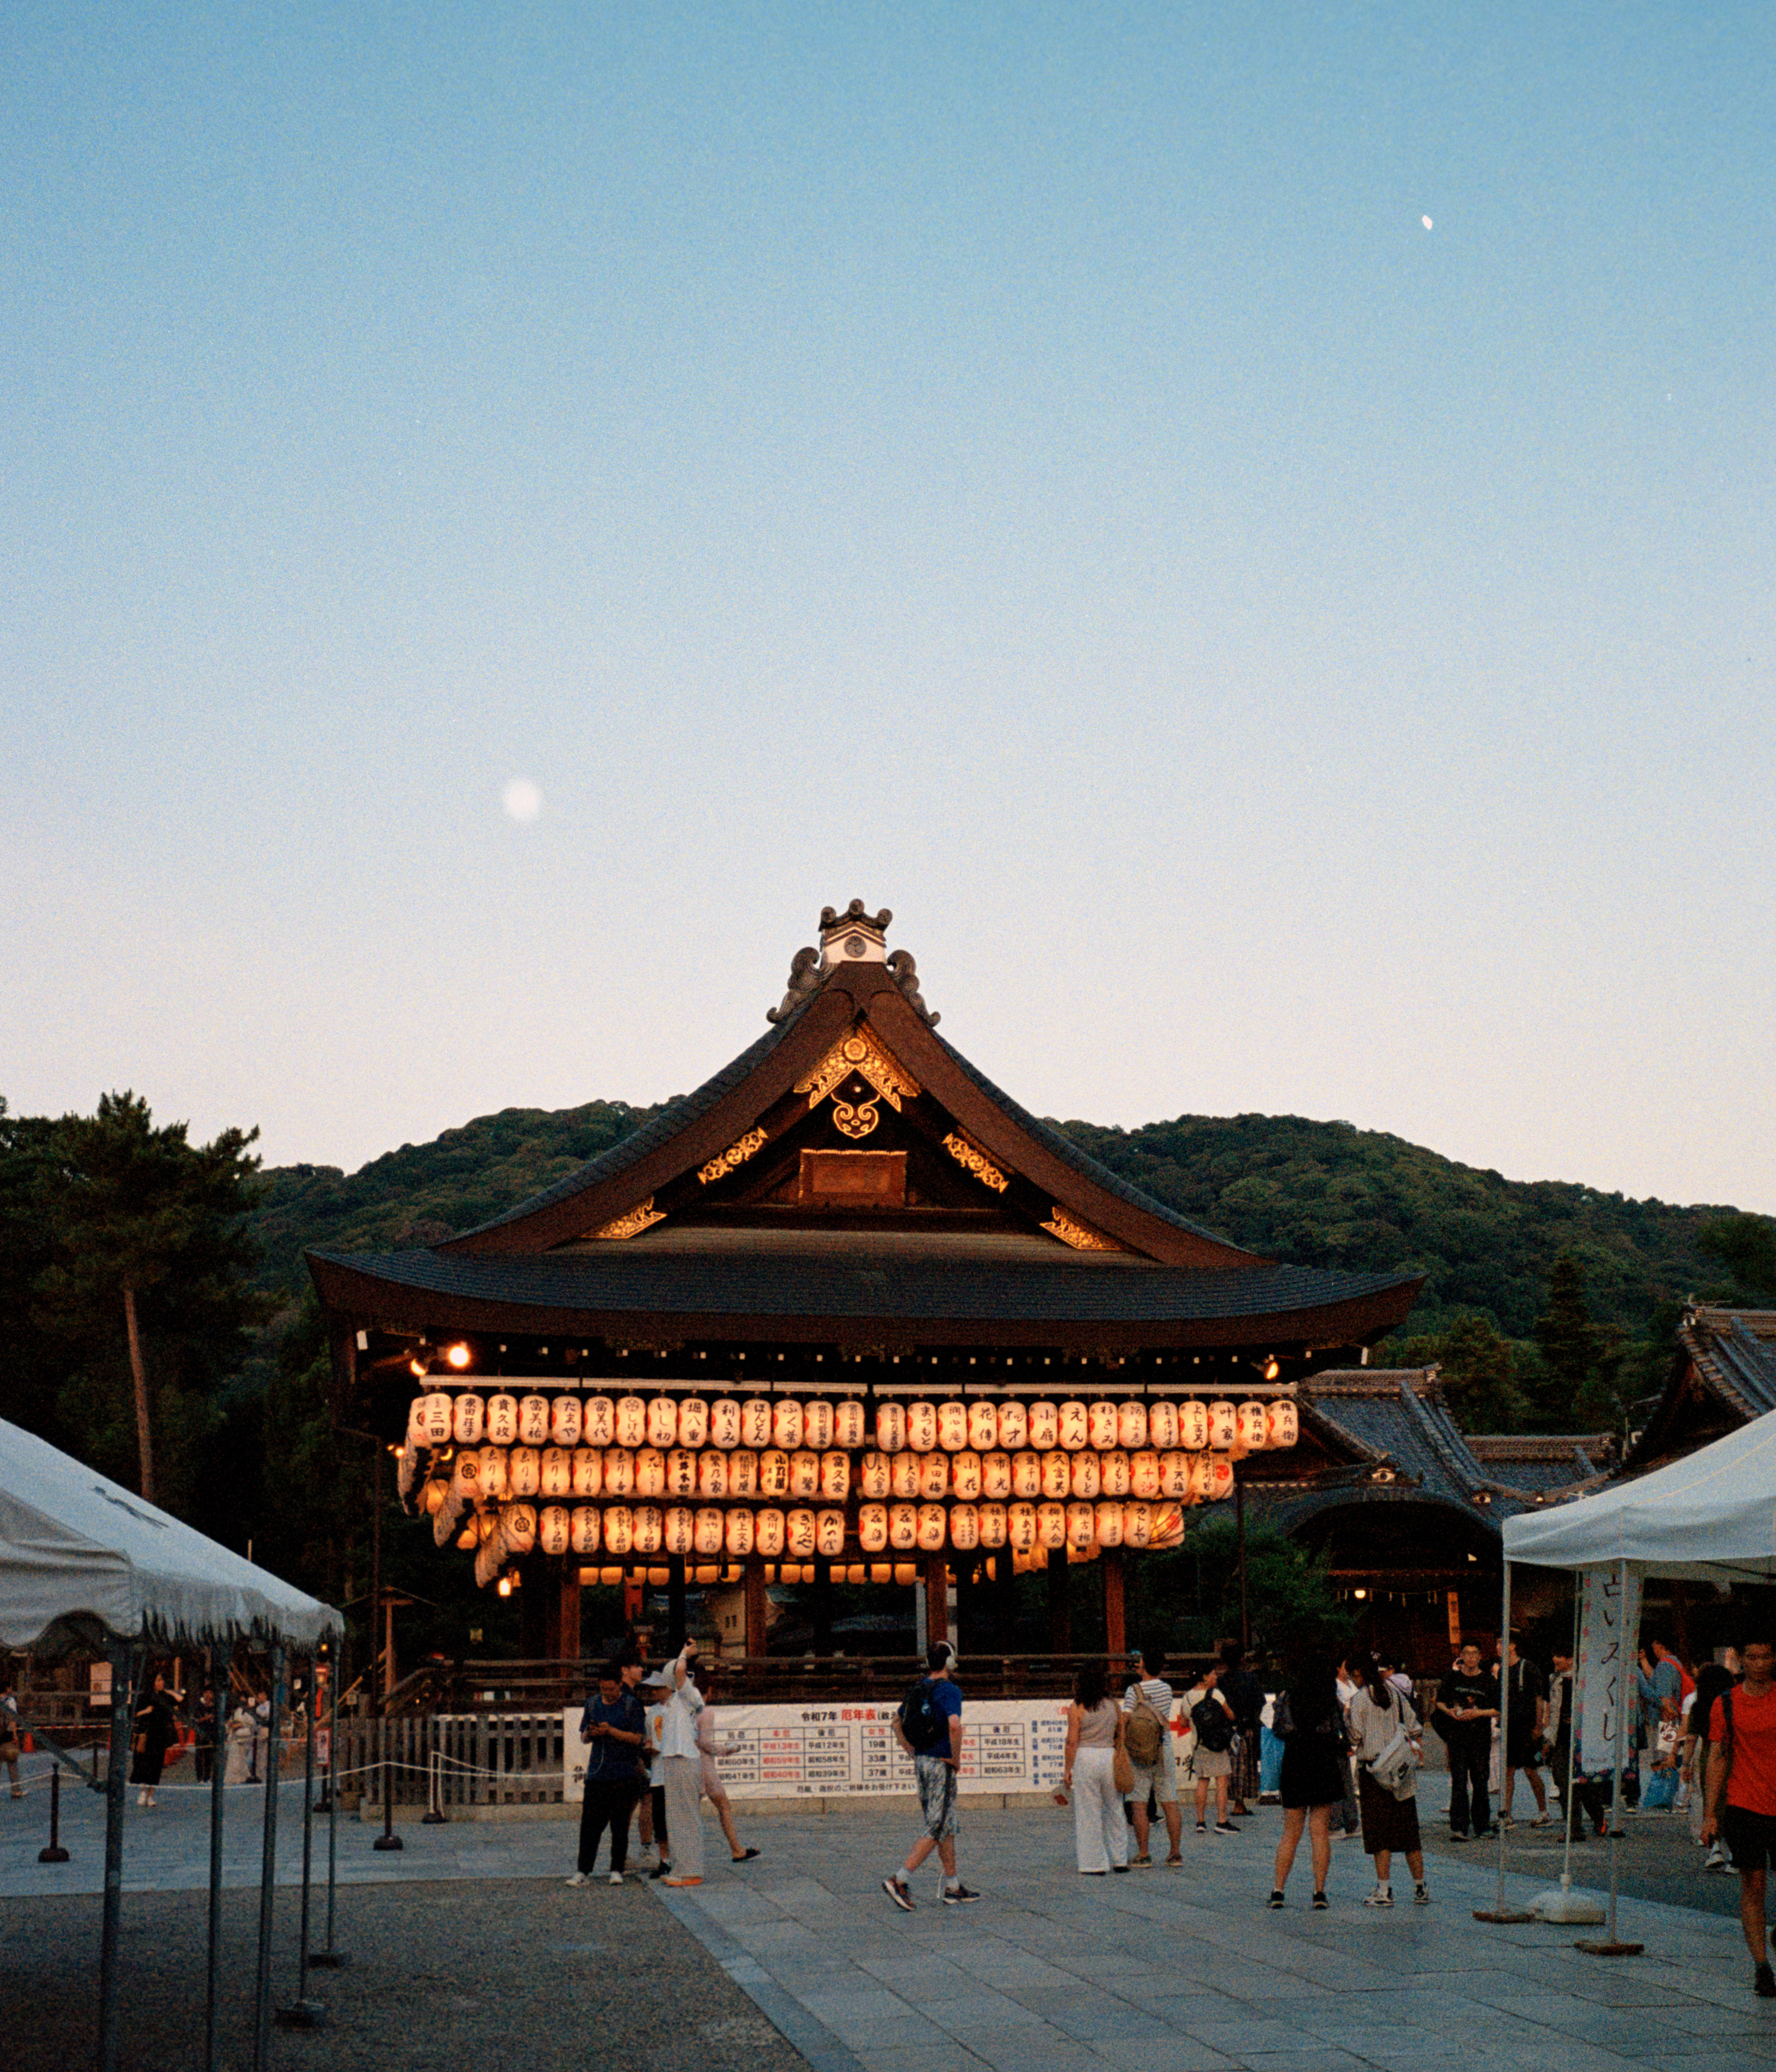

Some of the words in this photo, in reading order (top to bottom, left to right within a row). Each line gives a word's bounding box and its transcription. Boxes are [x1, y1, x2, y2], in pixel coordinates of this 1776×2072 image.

[430, 1411, 445, 1437] 三田
[562, 1401, 577, 1437] たまや
[594, 1400, 608, 1439] 富美代
[687, 1402, 702, 1442] 堀八重
[921, 1405, 932, 1446] まつもと
[1220, 1407, 1233, 1441] 叶家
[964, 1459, 977, 1491] 小花
[737, 1511, 748, 1552] 井上文太
[801, 1711, 837, 1722] 令和7年
